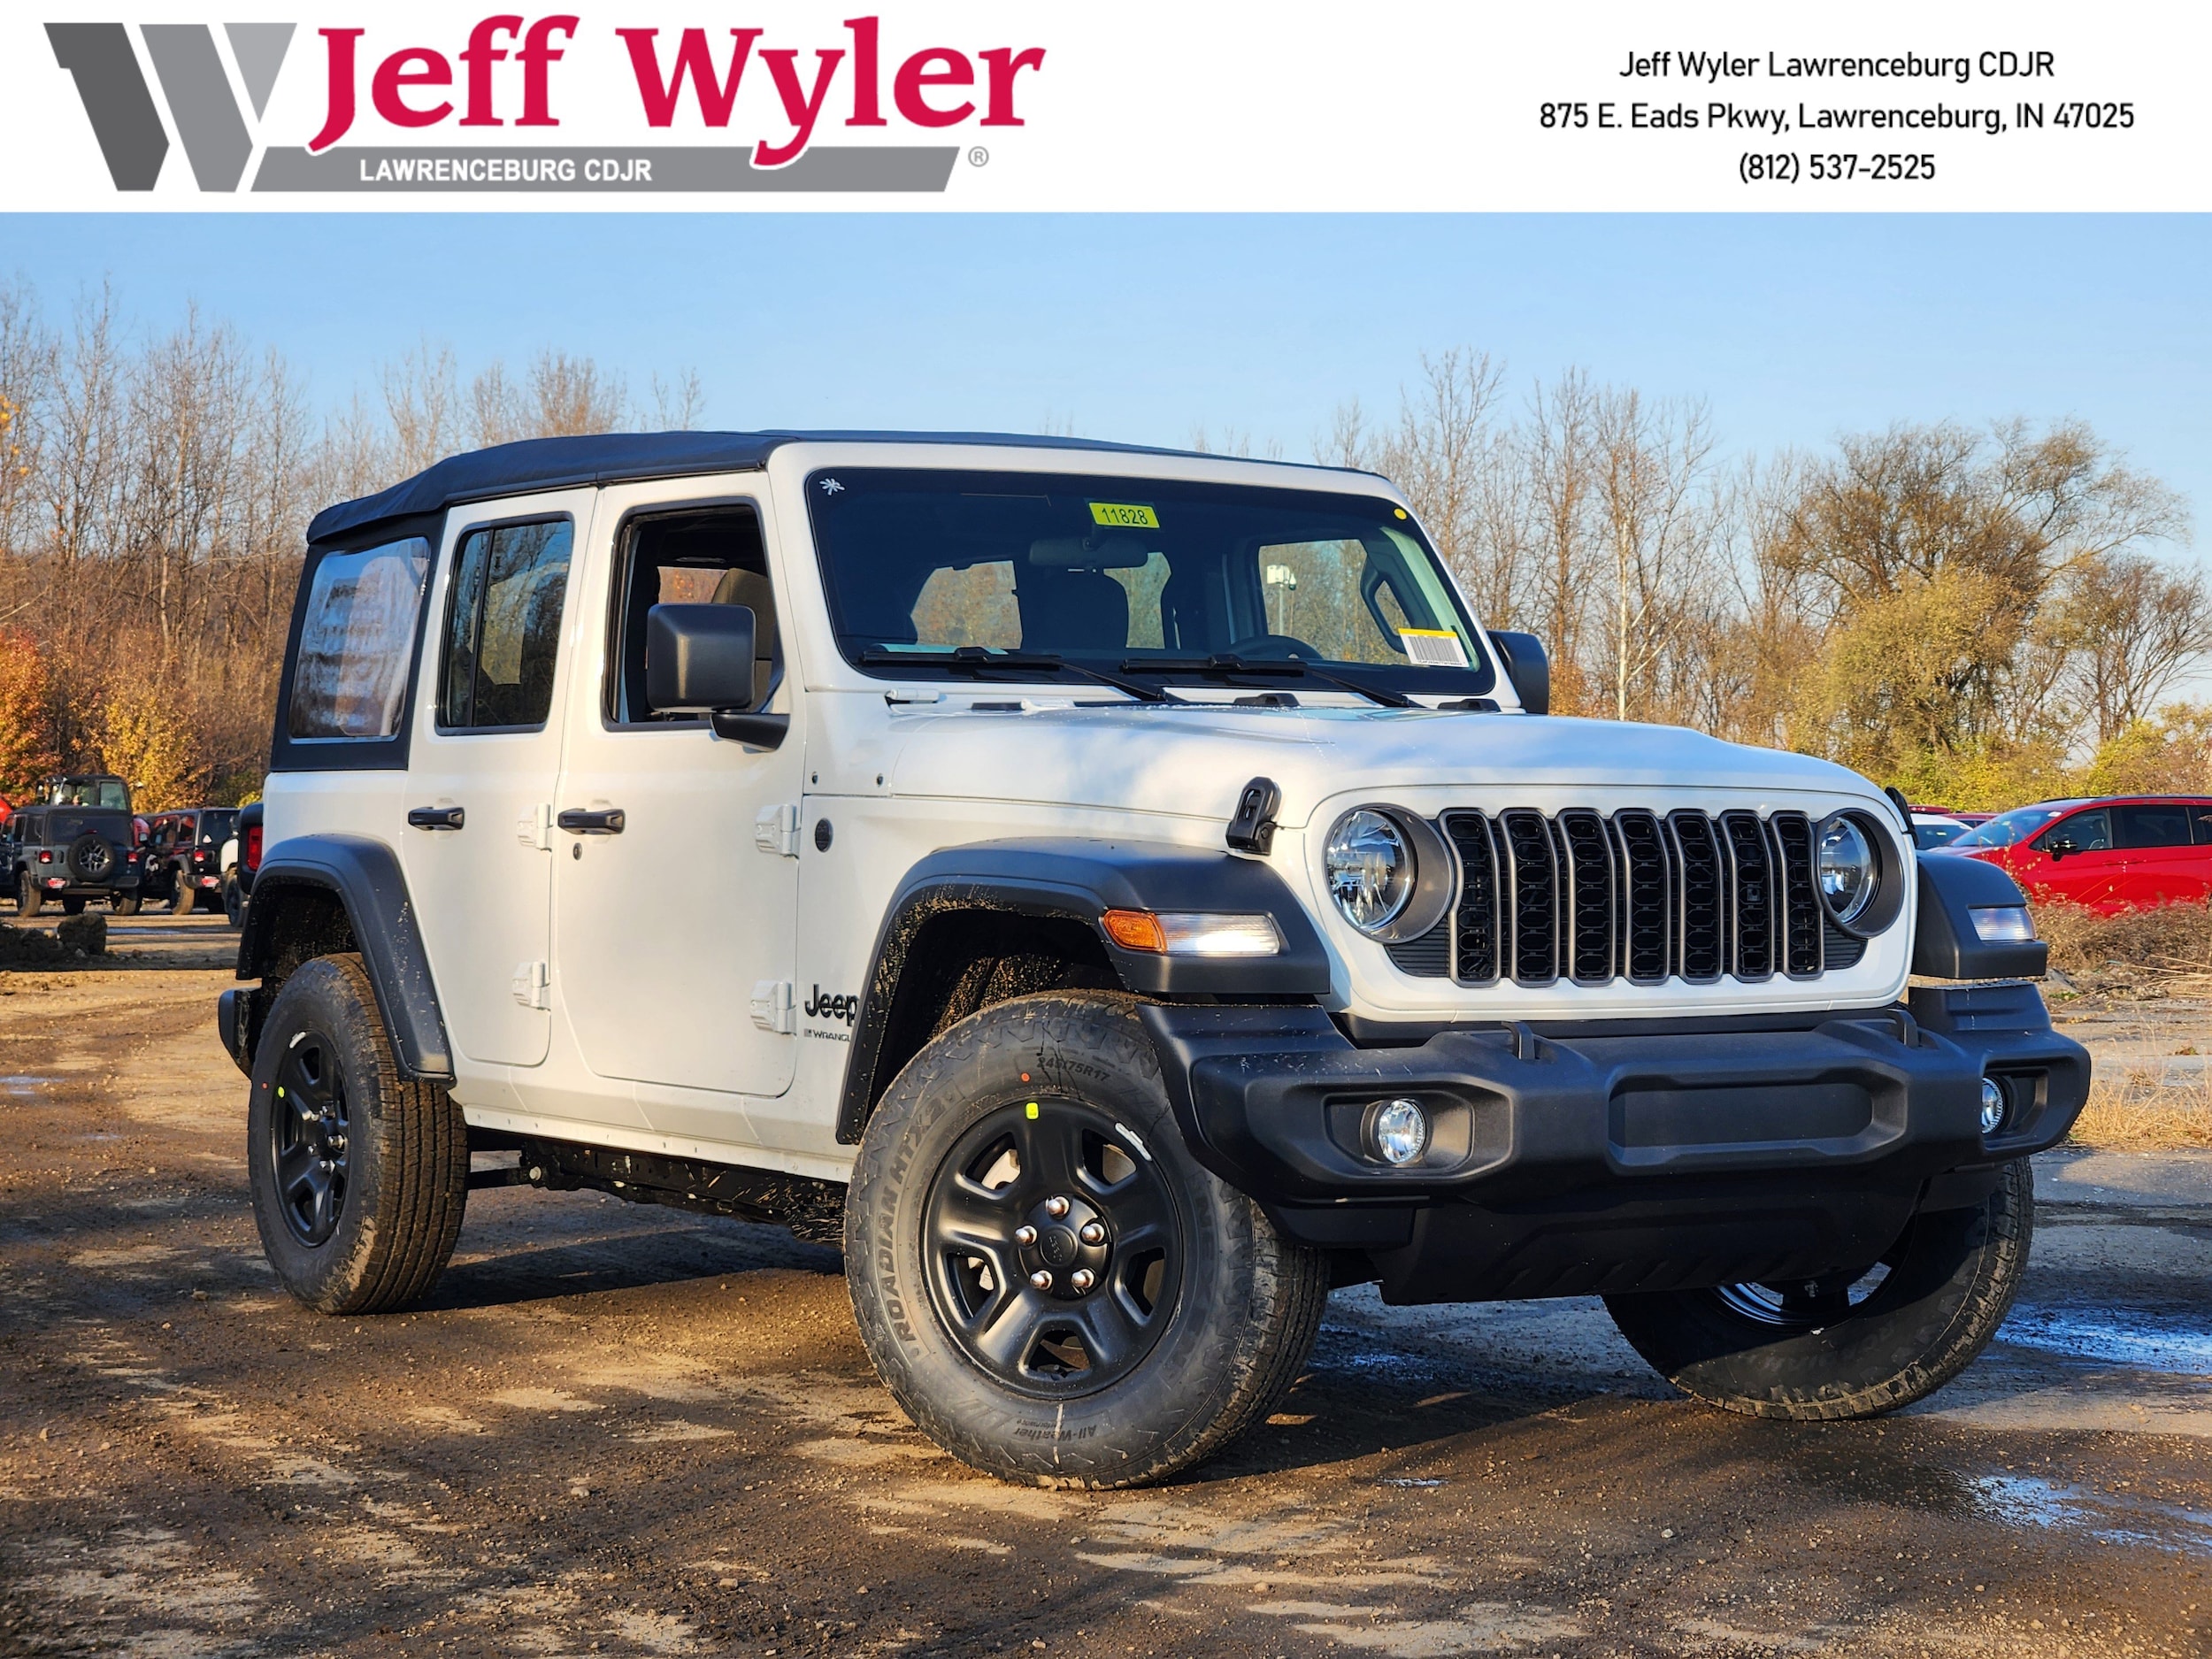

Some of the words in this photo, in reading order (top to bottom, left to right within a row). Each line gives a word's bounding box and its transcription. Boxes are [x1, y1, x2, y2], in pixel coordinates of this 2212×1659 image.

[1102, 508, 1148, 525] 11828
[804, 983, 859, 1027] Jeep
[813, 1029, 850, 1042] WRANGL
[878, 1186, 917, 1342] ROADIAN
